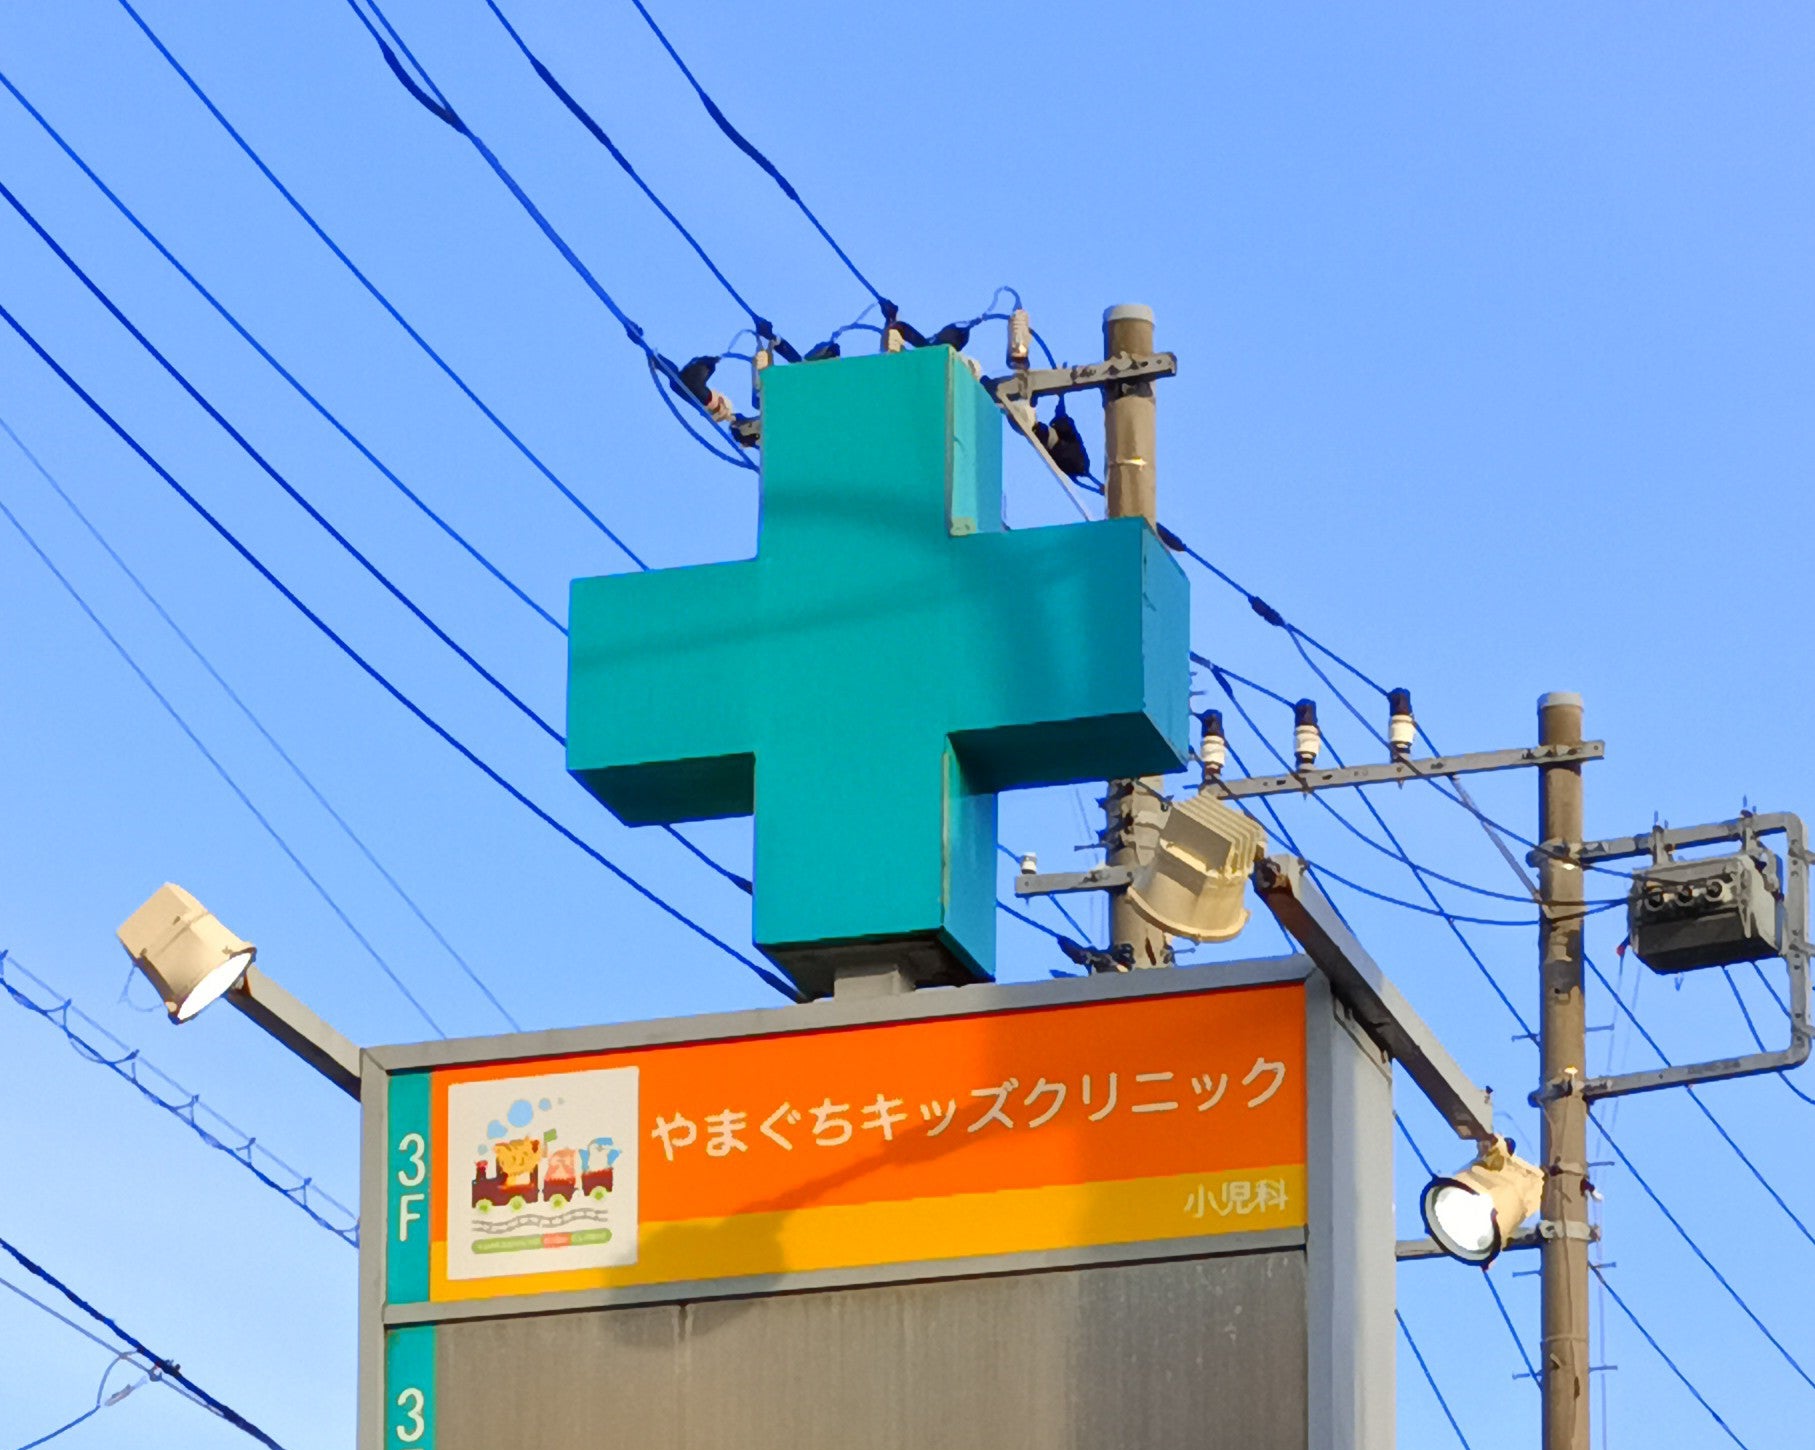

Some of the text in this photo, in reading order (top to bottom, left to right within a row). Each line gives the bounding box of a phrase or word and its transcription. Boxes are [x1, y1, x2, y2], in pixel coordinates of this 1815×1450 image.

[651, 1055, 1289, 1160] やまぐちキッズクリニック
[397, 1132, 427, 1242] 3F
[1182, 1178, 1289, 1219] 小児科
